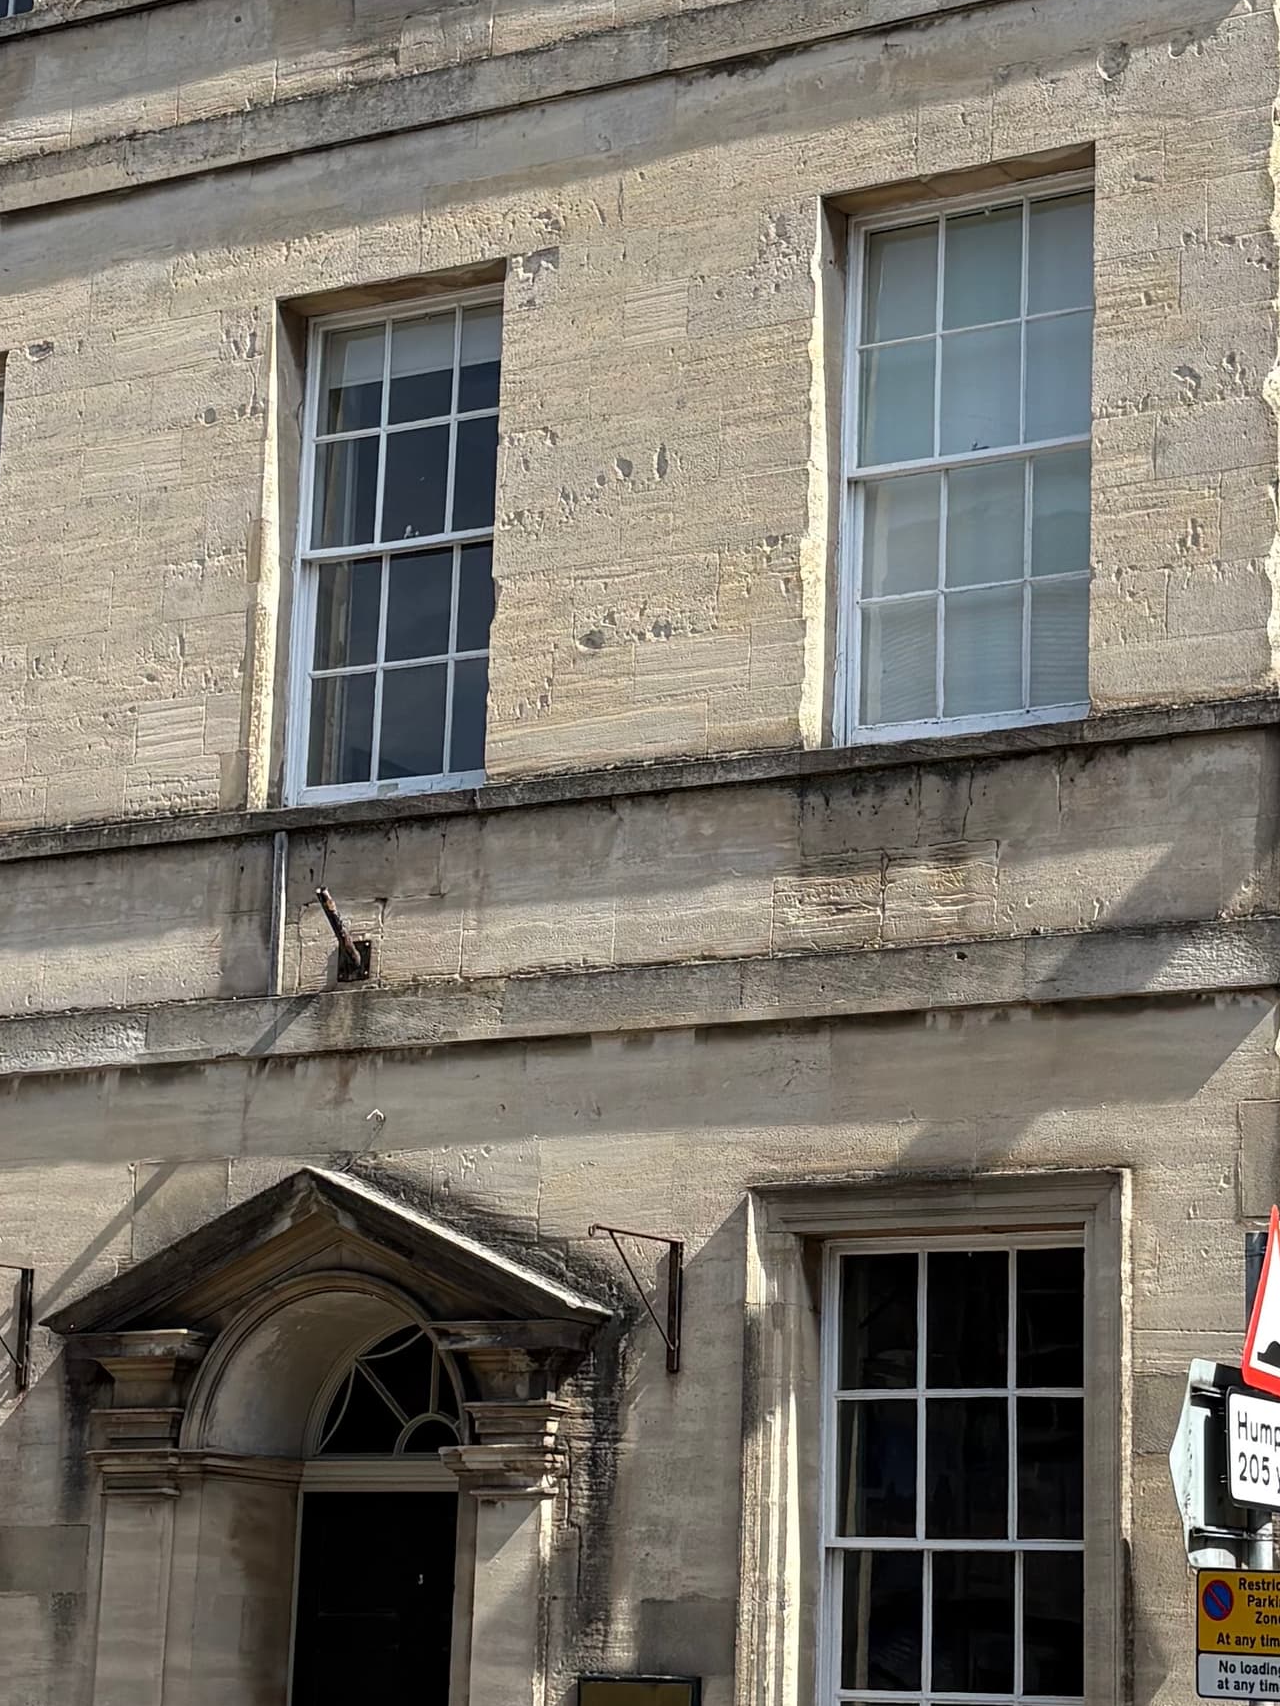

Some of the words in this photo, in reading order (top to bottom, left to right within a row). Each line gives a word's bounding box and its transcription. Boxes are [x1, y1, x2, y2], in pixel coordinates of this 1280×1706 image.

[1238, 1451, 1270, 1486] 205
[1216, 1632, 1231, 1646] At
[1235, 1635, 1256, 1648] any
[1218, 1660, 1236, 1674] No
[1217, 1677, 1229, 1690] at
[1233, 1680, 1255, 1694] any
